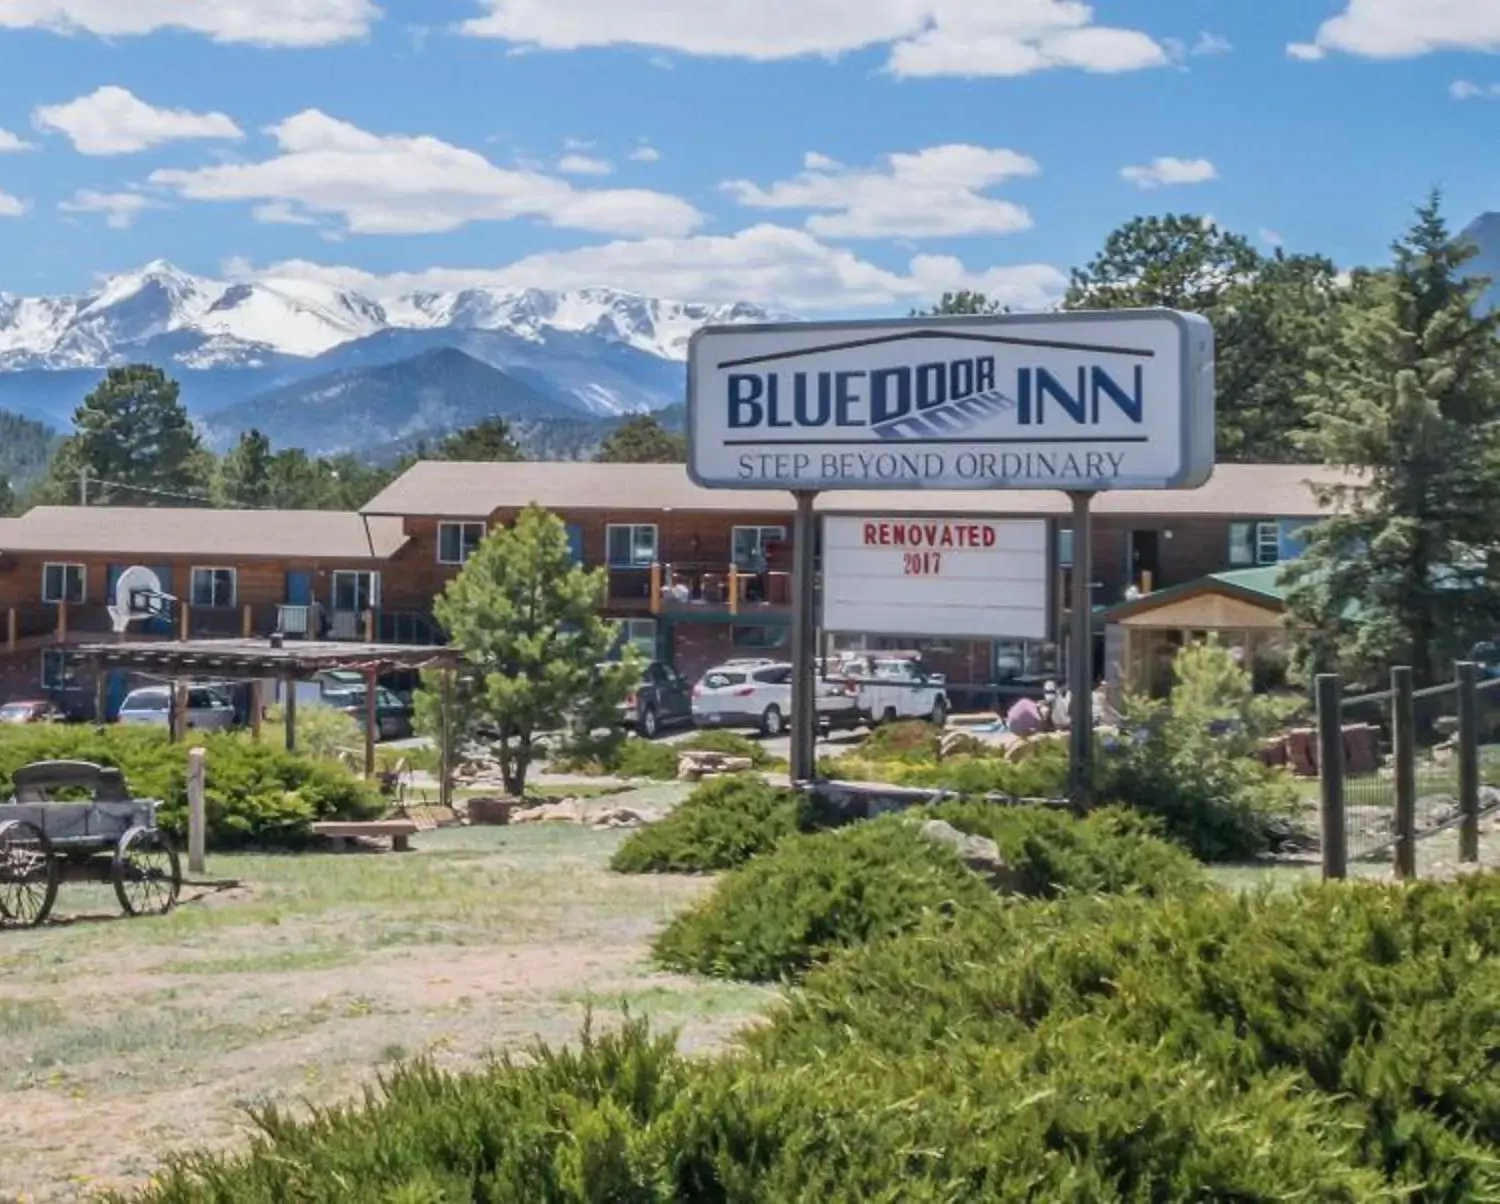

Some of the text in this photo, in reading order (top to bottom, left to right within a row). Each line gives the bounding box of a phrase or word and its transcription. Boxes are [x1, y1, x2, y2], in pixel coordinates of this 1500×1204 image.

[1017, 364, 1143, 425] INN
[738, 452, 1125, 479] STEP BEYOND ORDINARY
[863, 522, 997, 547] RENOVATED
[903, 552, 941, 575] 2017
